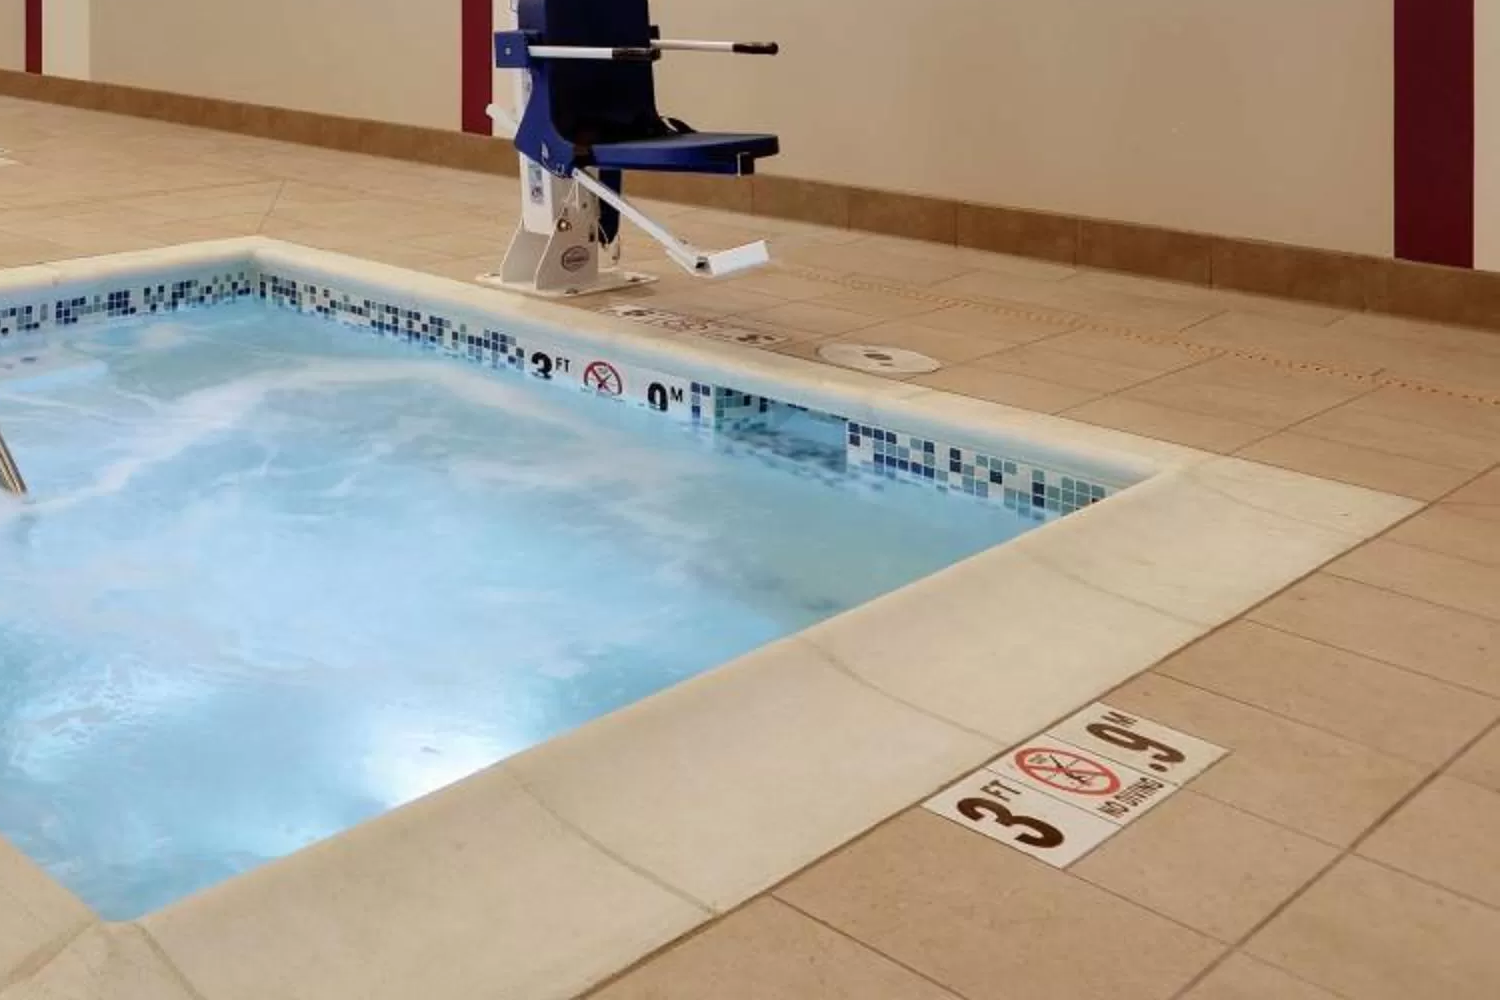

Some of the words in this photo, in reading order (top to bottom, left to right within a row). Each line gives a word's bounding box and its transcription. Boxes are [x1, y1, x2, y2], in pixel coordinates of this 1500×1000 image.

[555, 357, 570, 372] FT
[980, 779, 1022, 802] FT
[956, 797, 1065, 849] 3
